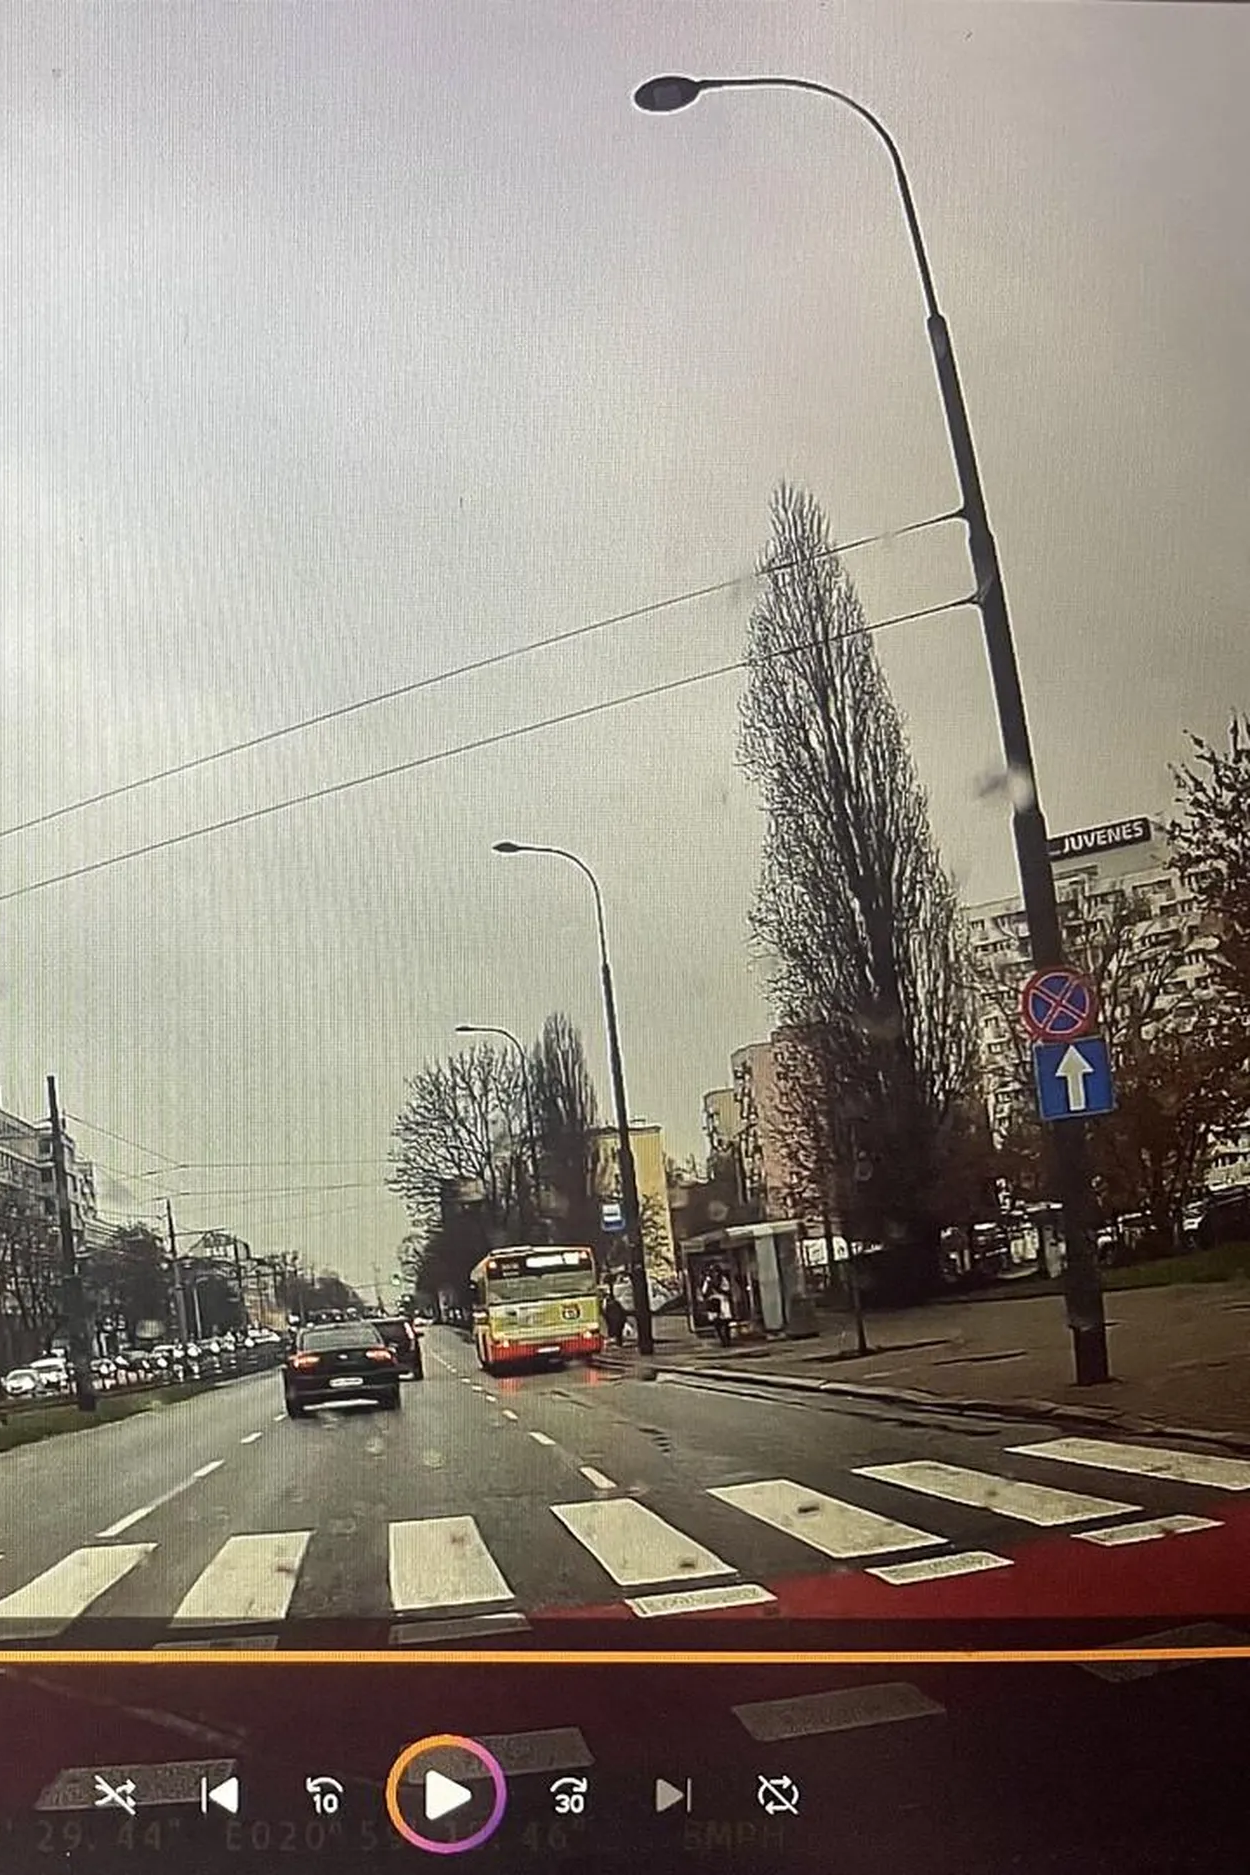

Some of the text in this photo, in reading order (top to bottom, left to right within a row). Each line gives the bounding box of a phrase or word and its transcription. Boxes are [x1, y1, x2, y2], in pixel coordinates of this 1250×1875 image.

[1062, 821, 1144, 854] JUVENES
[313, 1794, 338, 1814] 10
[555, 1794, 584, 1814] 30
